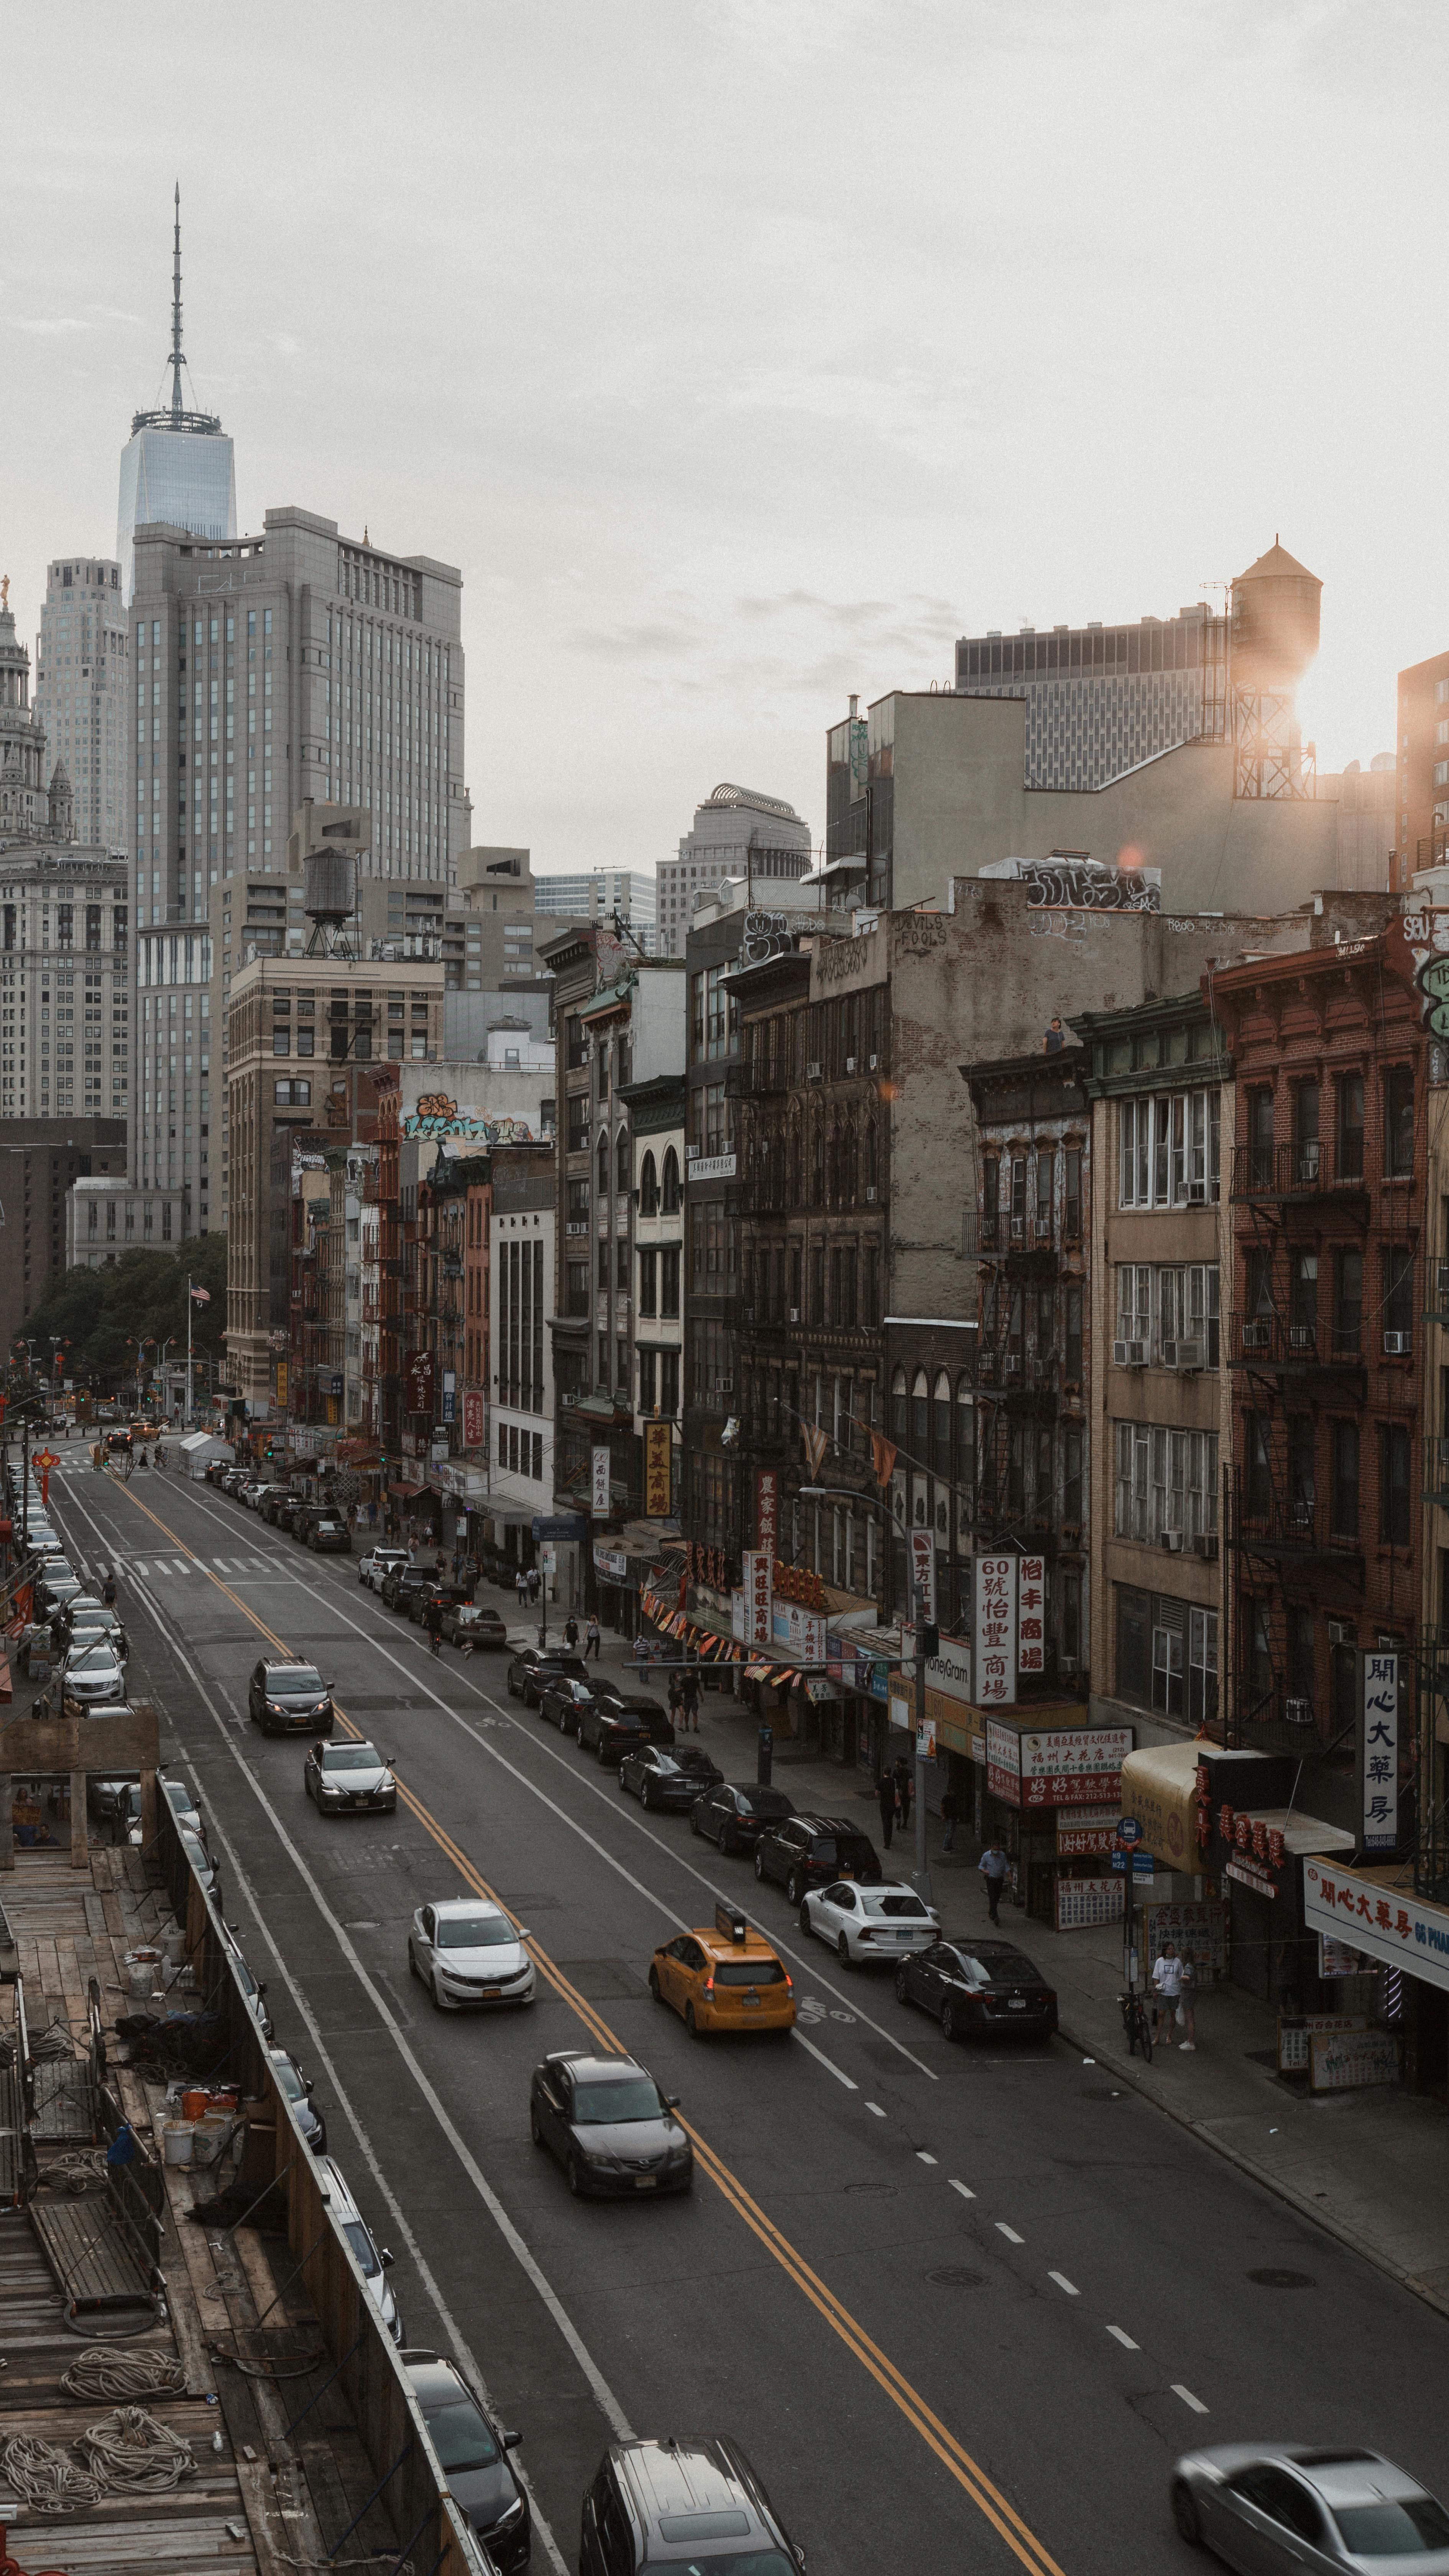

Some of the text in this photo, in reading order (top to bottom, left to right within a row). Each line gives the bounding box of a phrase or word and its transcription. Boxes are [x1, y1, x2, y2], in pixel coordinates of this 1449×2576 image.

[902, 930, 947, 945] FOOLS
[649, 1427, 669, 1513] 華美商場
[595, 1465, 606, 1506] 西餅屋
[754, 1557, 769, 1643] 興旺旺商場
[1365, 1659, 1395, 1824] 開心大藥房
[1031, 1748, 1105, 1763] 福州大花店
[1061, 1880, 1122, 1893] 福州大花店
[1415, 1922, 1426, 1944] 66
[1294, 2019, 1353, 2031] 州百合花店
